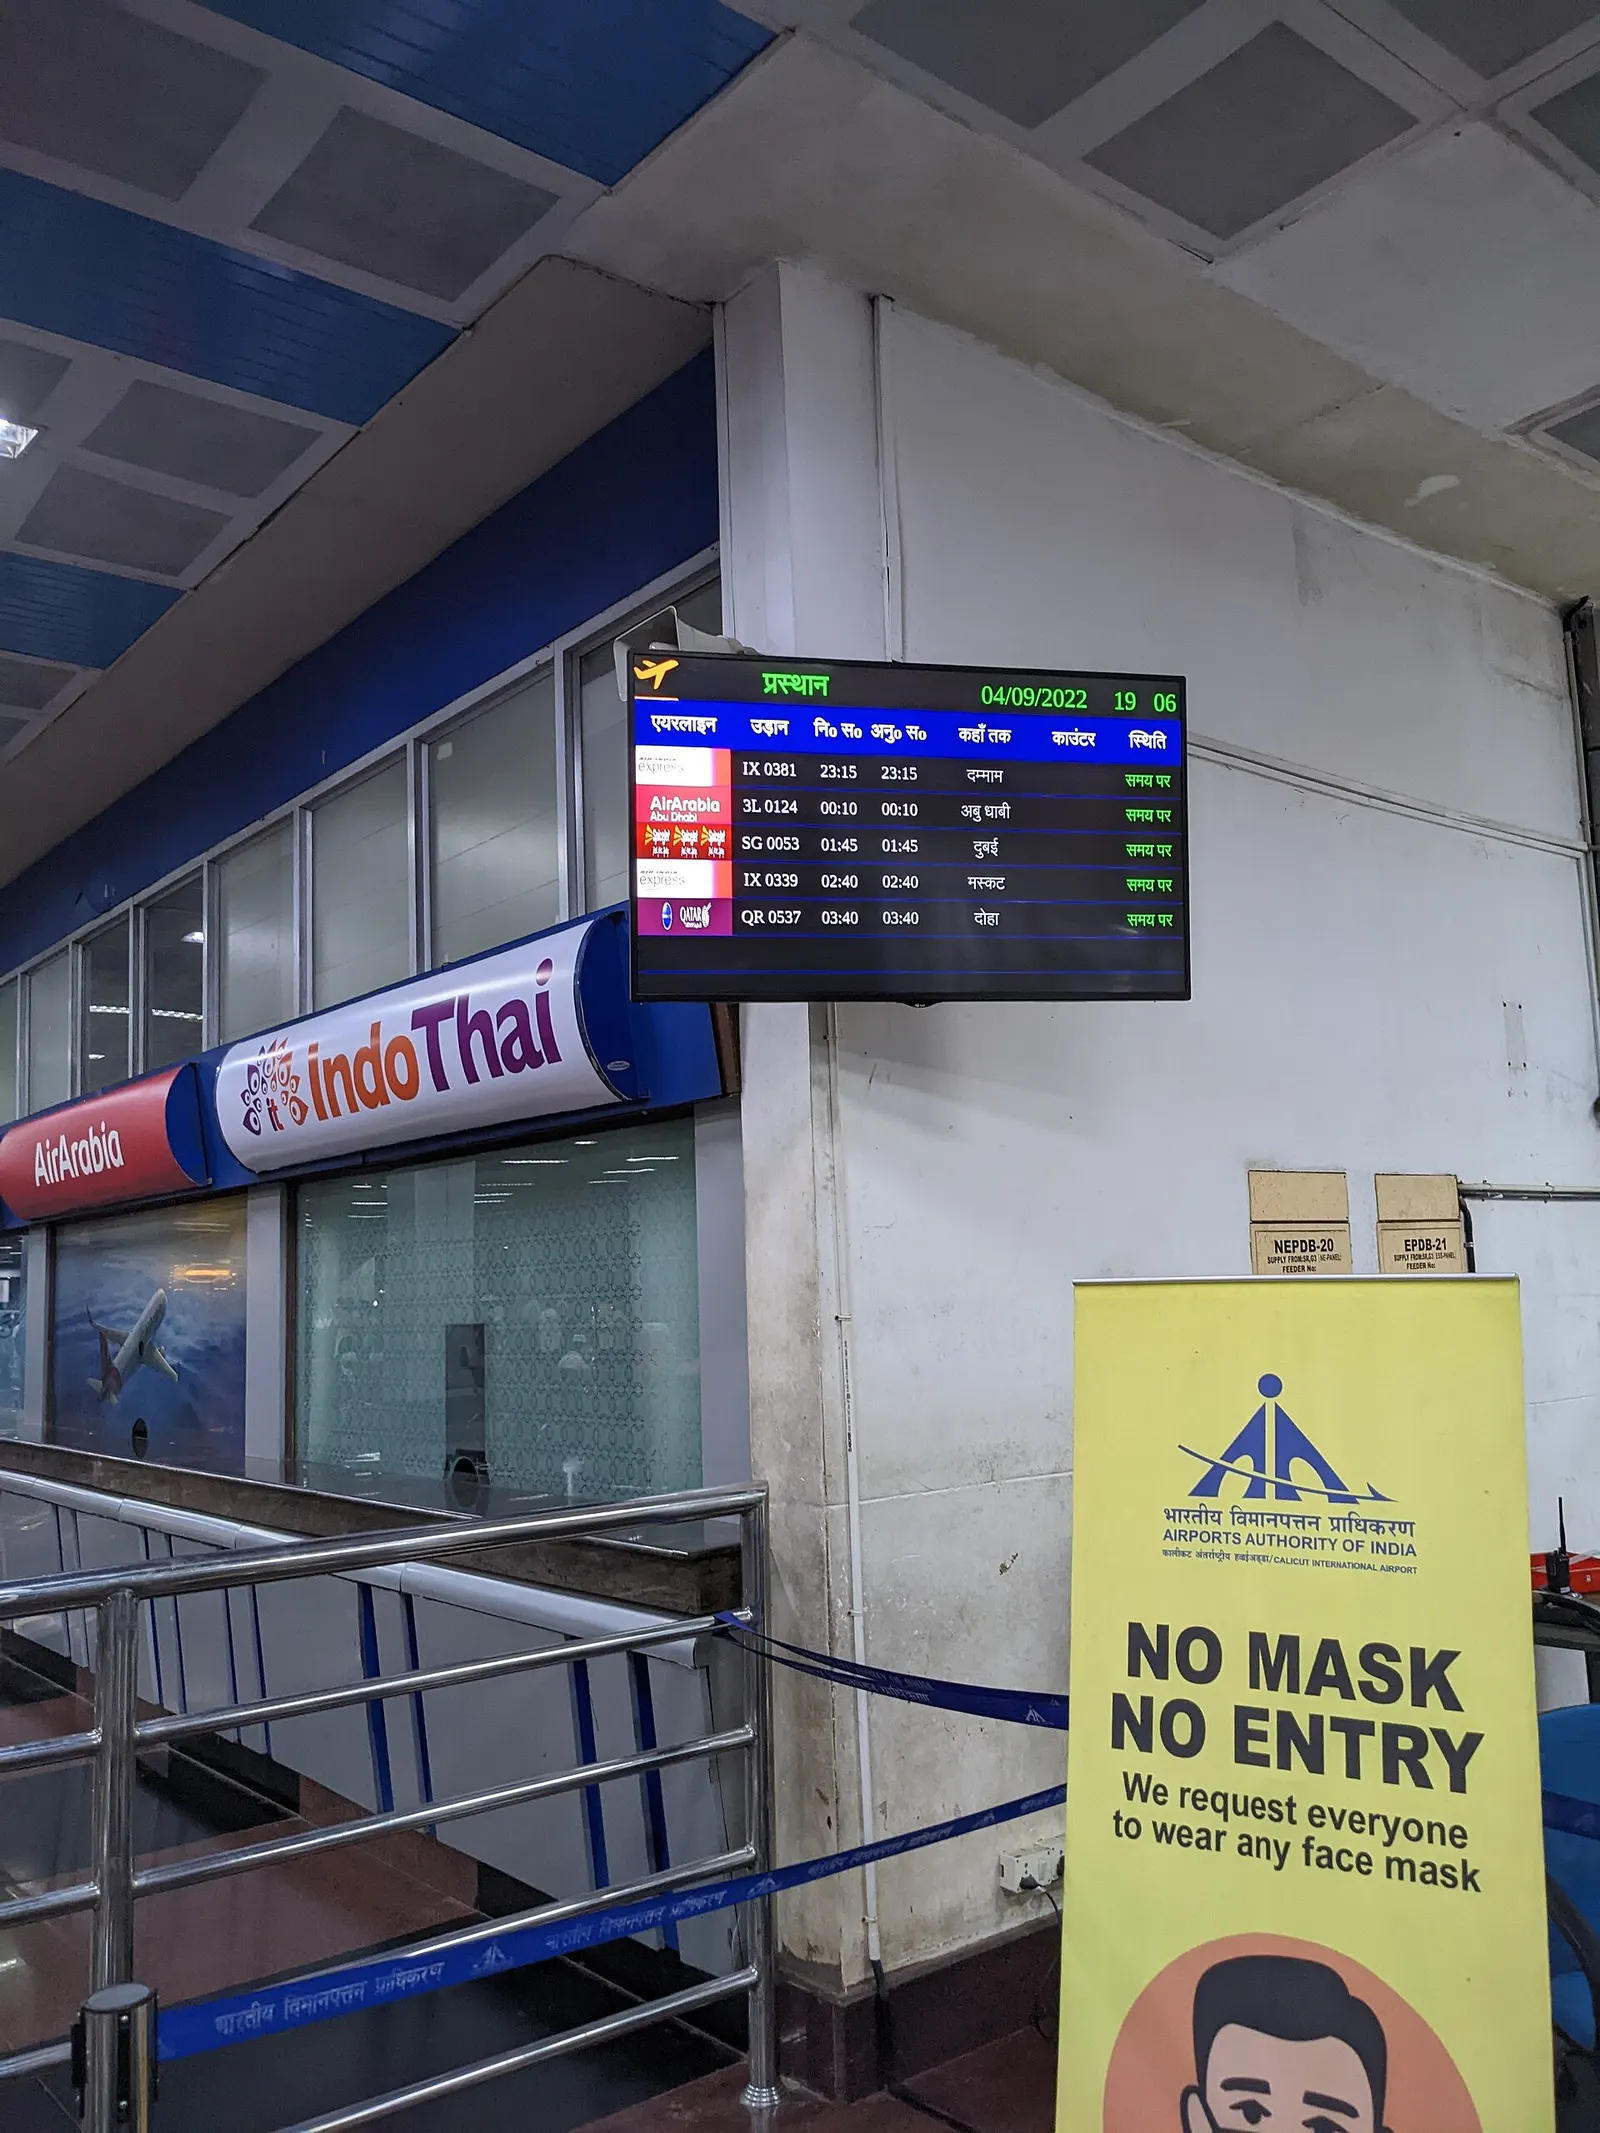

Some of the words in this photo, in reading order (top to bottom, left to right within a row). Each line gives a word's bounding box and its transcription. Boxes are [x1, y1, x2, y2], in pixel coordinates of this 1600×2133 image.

[762, 672, 831, 697] प्रस्थान
[981, 685, 1088, 709] 04/09/2022
[1114, 692, 1137, 711] 19
[1153, 693, 1177, 712] 06
[650, 714, 718, 735] एयरलाइन
[750, 718, 790, 738] उड़ान
[958, 723, 987, 744] कहाँ
[988, 728, 1012, 744] तक
[1052, 728, 1097, 747] काउंटर
[1128, 729, 1167, 749] स्थिति
[742, 761, 761, 776] IX
[764, 762, 797, 777] 0381
[820, 764, 858, 779] 23:15
[881, 766, 918, 781] 23:15
[966, 768, 1004, 783] दम्माम
[1125, 773, 1154, 788] समय
[1156, 774, 1172, 788] पर
[650, 795, 721, 813] AirArabia
[742, 799, 761, 813] 3L
[765, 800, 798, 814] 0124
[820, 801, 858, 815] 00:10
[881, 802, 918, 817] 00:10
[960, 804, 982, 822] अबु
[984, 802, 1011, 819] धाबी
[1125, 808, 1154, 823] समय
[1156, 809, 1172, 823] पर
[650, 811, 670, 822] Abu
[671, 811, 698, 823] Dhabi
[742, 836, 763, 850] SG
[766, 836, 800, 850] 0053
[821, 838, 858, 852] 01:45
[882, 839, 919, 853] 01:45
[973, 837, 999, 858] दुबई
[1126, 843, 1154, 857] समय
[1157, 844, 1172, 858] पर
[743, 872, 762, 887] IX
[765, 873, 799, 887] 0339
[821, 874, 859, 888] 02:40
[882, 875, 919, 889] 02:40
[967, 876, 1006, 890] मस्कट
[1126, 878, 1155, 892] समय
[1157, 879, 1173, 893] पर
[680, 906, 702, 923] QATAR
[741, 910, 765, 925] QR
[767, 910, 802, 924] 0537
[821, 911, 859, 925] 03:40
[882, 912, 919, 926] 03:40
[973, 907, 1000, 926] दोहा
[1127, 913, 1155, 927] समय
[1158, 914, 1174, 928] पर
[34, 1121, 124, 1188] AirArabia
[1273, 1238, 1334, 1254] NEPDB-20
[1404, 1237, 1447, 1252] EPDB-21
[1267, 1255, 1287, 1264] SUPPLY
[1282, 1265, 1306, 1273] FEEDER
[1163, 1503, 1223, 1526] भारतीय
[1230, 1505, 1322, 1532] विमानपत्तन
[1328, 1511, 1416, 1537] प्राधिकरण
[1163, 1529, 1242, 1545] AIRPORTS
[1245, 1532, 1338, 1552] AUTHORITY
[1342, 1539, 1365, 1553] OF
[1370, 1541, 1418, 1558] INDIA
[1311, 1559, 1378, 1572] INTERNATIONAL
[1379, 1565, 1418, 1575] AIRPORT
[1127, 1621, 1223, 1685] NO
[1248, 1631, 1465, 1713] MASK
[1111, 1692, 1206, 1759] NO
[1233, 1704, 1485, 1795] ENTRY
[1122, 1770, 1169, 1807] We
[1179, 1785, 1298, 1826] request
[1307, 1803, 1469, 1850] everyone
[1113, 1809, 1142, 1840] to
[1152, 1819, 1227, 1853] wear
[1236, 1832, 1291, 1872] any
[1301, 1835, 1374, 1876] face
[1385, 1855, 1482, 1893] mask
[214, 1997, 277, 2035] भारतीय
